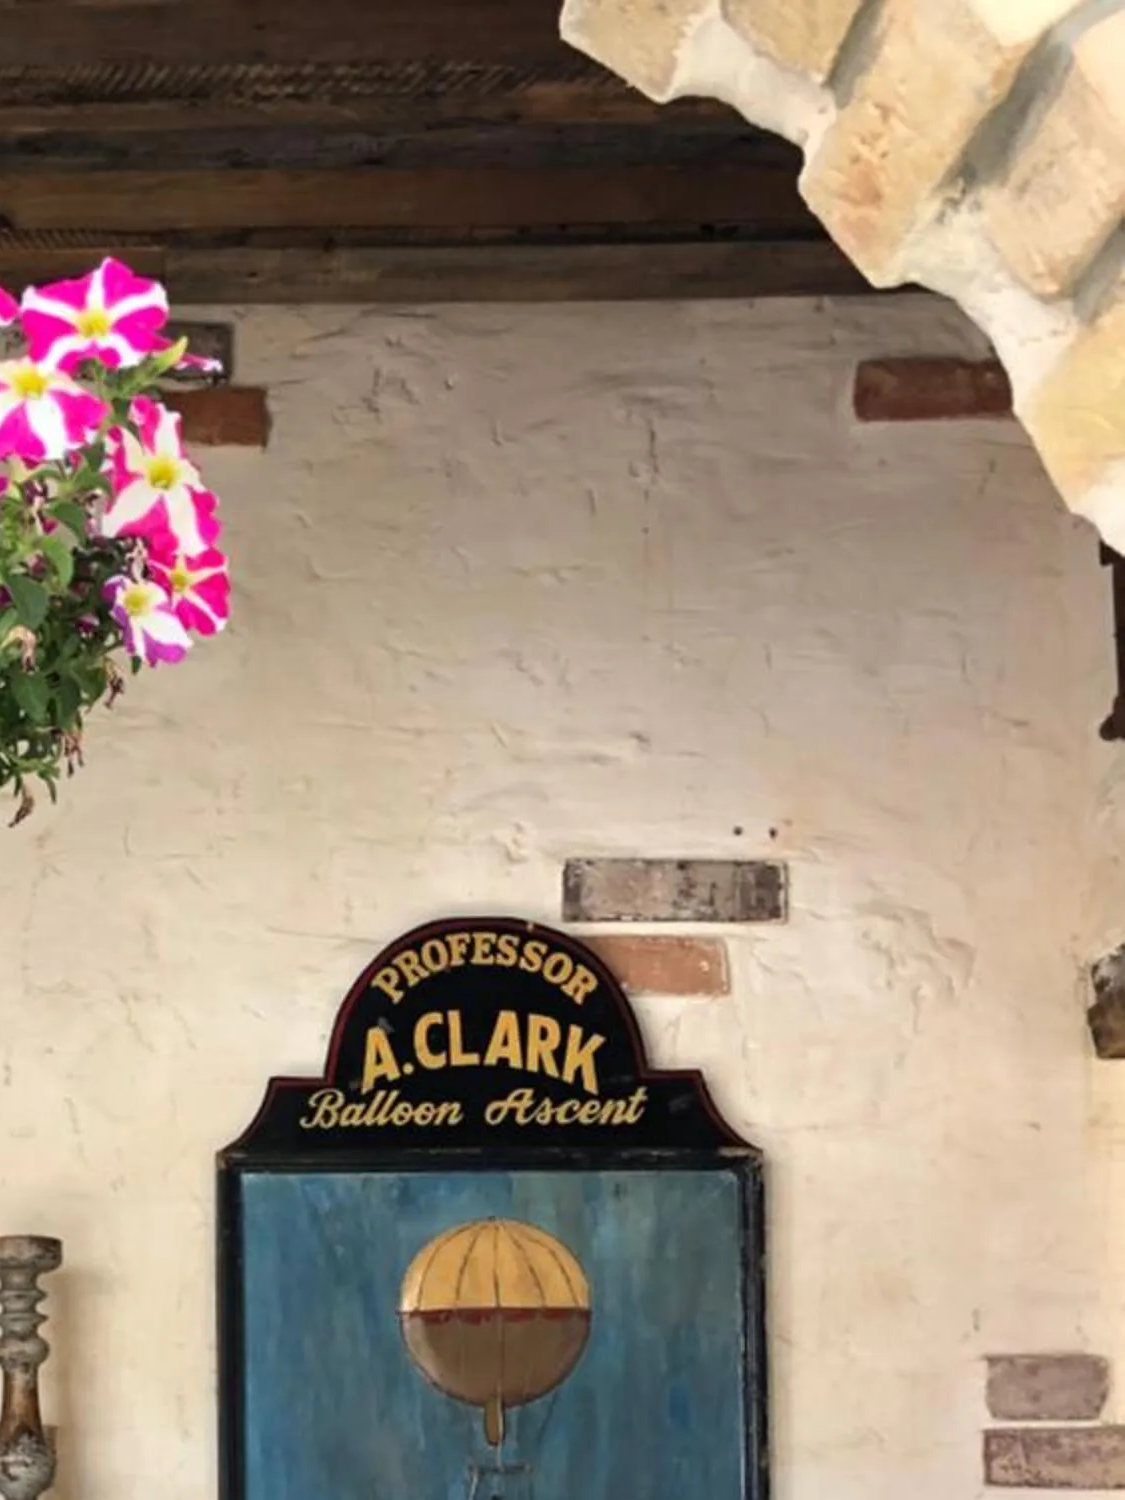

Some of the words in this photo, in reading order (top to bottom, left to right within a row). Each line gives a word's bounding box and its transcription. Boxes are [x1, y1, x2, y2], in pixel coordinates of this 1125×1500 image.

[371, 931, 599, 1005] PROFESSOR
[299, 1087, 463, 1129] Balloon
[484, 1086, 648, 1126] Ascent
